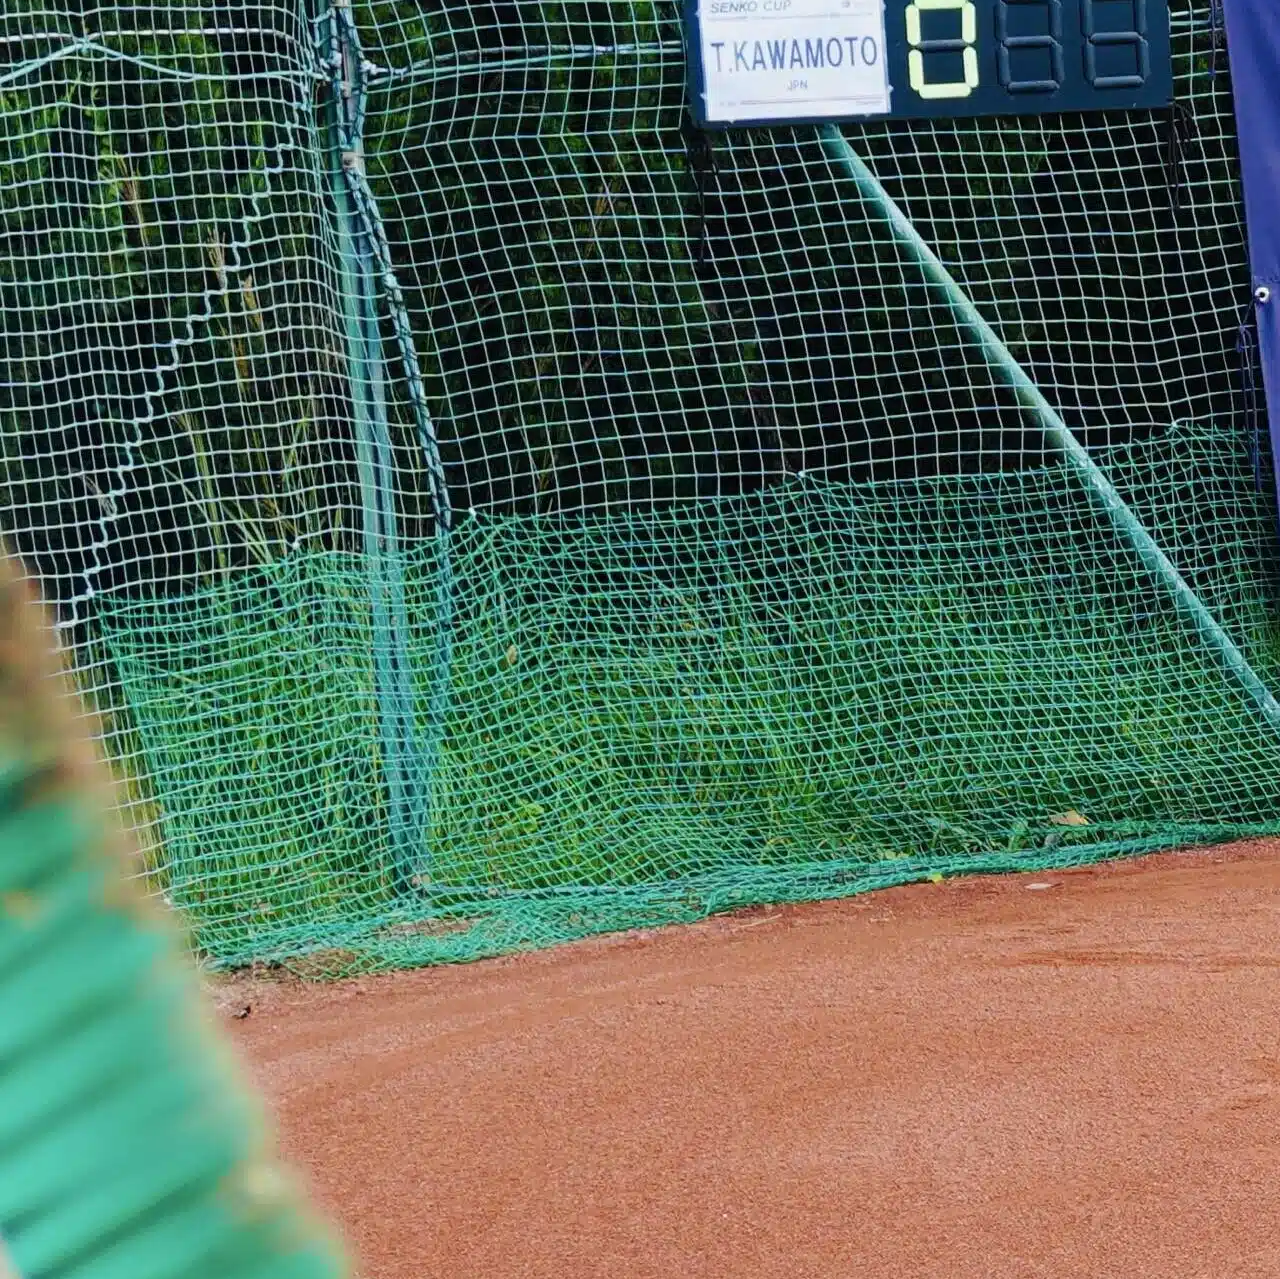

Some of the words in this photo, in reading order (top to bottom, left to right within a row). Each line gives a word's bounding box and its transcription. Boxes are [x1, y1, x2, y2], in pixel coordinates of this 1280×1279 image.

[710, 0, 758, 14] SENKO
[763, 0, 792, 12] CUP
[710, 35, 878, 74] T.KAWAMOTO
[785, 80, 808, 92] JPN
